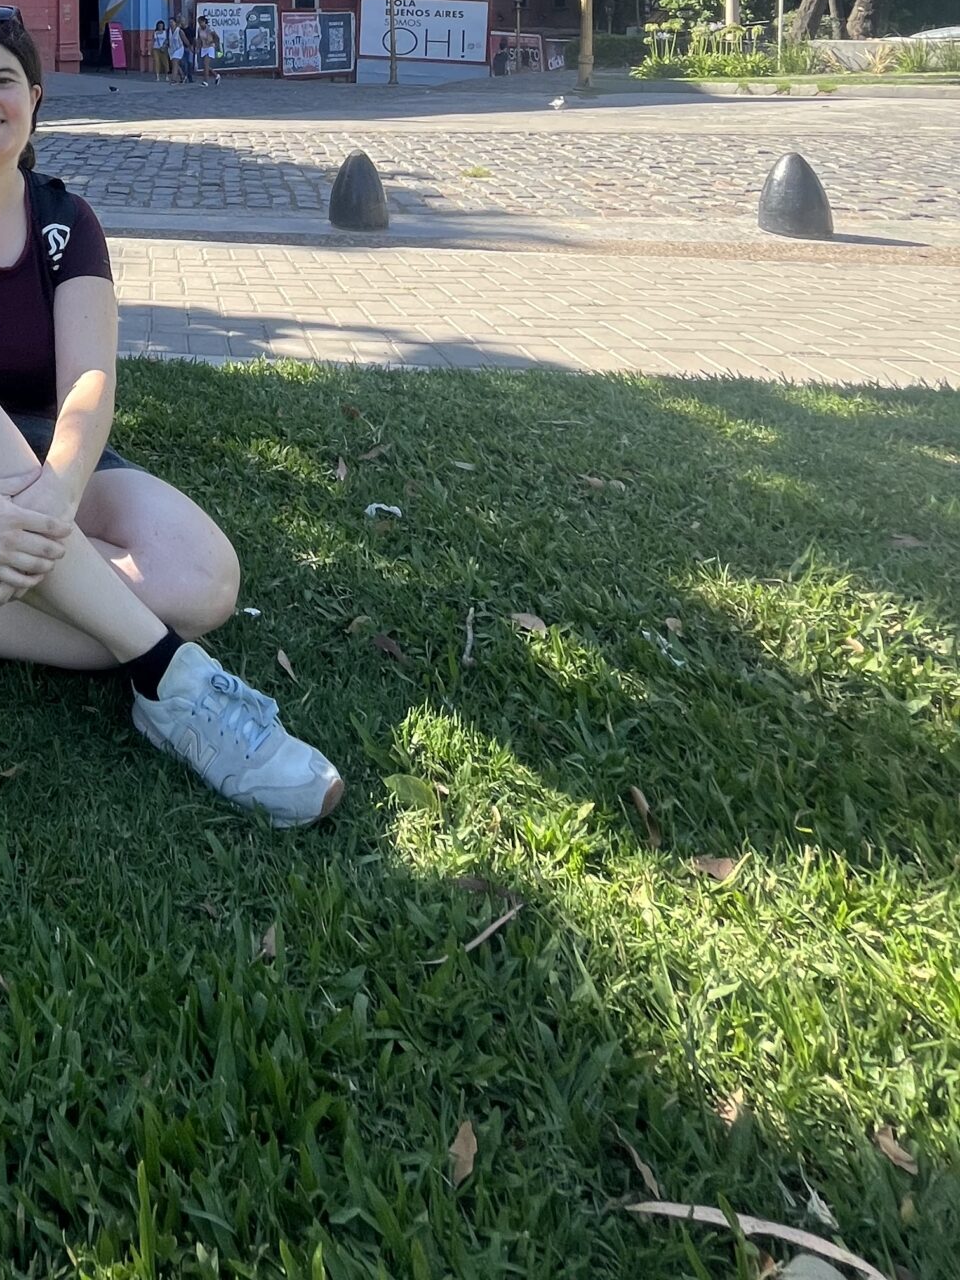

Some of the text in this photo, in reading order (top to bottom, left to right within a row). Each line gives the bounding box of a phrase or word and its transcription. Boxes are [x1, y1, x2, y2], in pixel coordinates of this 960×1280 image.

[385, 0, 416, 8] HOLA
[385, 8, 464, 19] BUENOS AIRES
[384, 18, 422, 27] SOMOS
[382, 27, 465, 58] OH!
